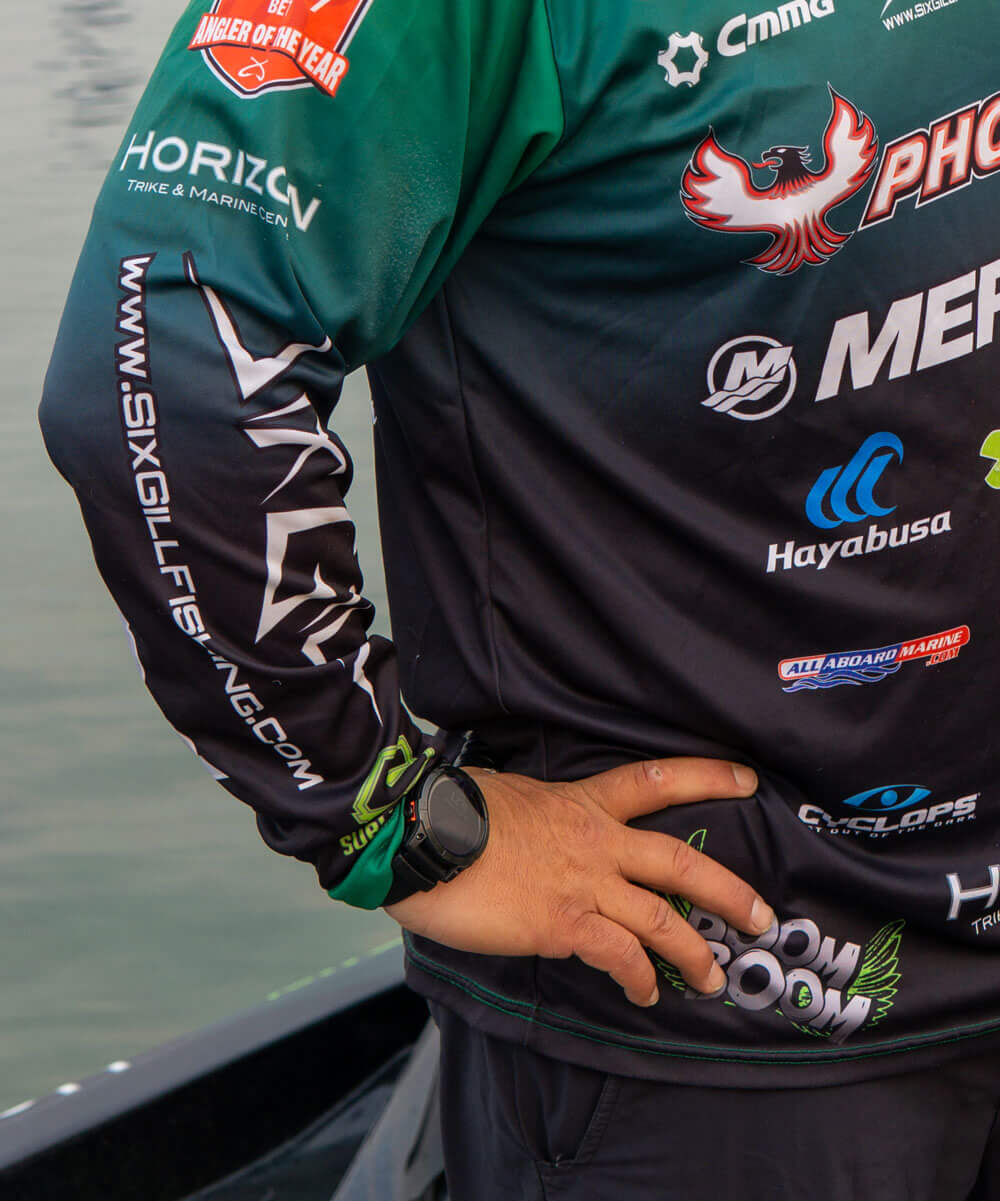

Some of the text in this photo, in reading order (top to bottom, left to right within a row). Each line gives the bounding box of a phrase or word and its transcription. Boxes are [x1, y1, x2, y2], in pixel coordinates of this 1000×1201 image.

[191, 15, 253, 46] ANGLER
[252, 23, 276, 46] OF
[298, 36, 347, 92] YEAR
[127, 179, 170, 195] TRIKE
[172, 183, 185, 197] &
[189, 185, 258, 217] MARINE
[766, 510, 952, 574] Hayabusa
[786, 630, 965, 676] ALL ABOARD MARINE
[797, 792, 978, 833] CYCLOPS
[339, 814, 386, 857] SUP
